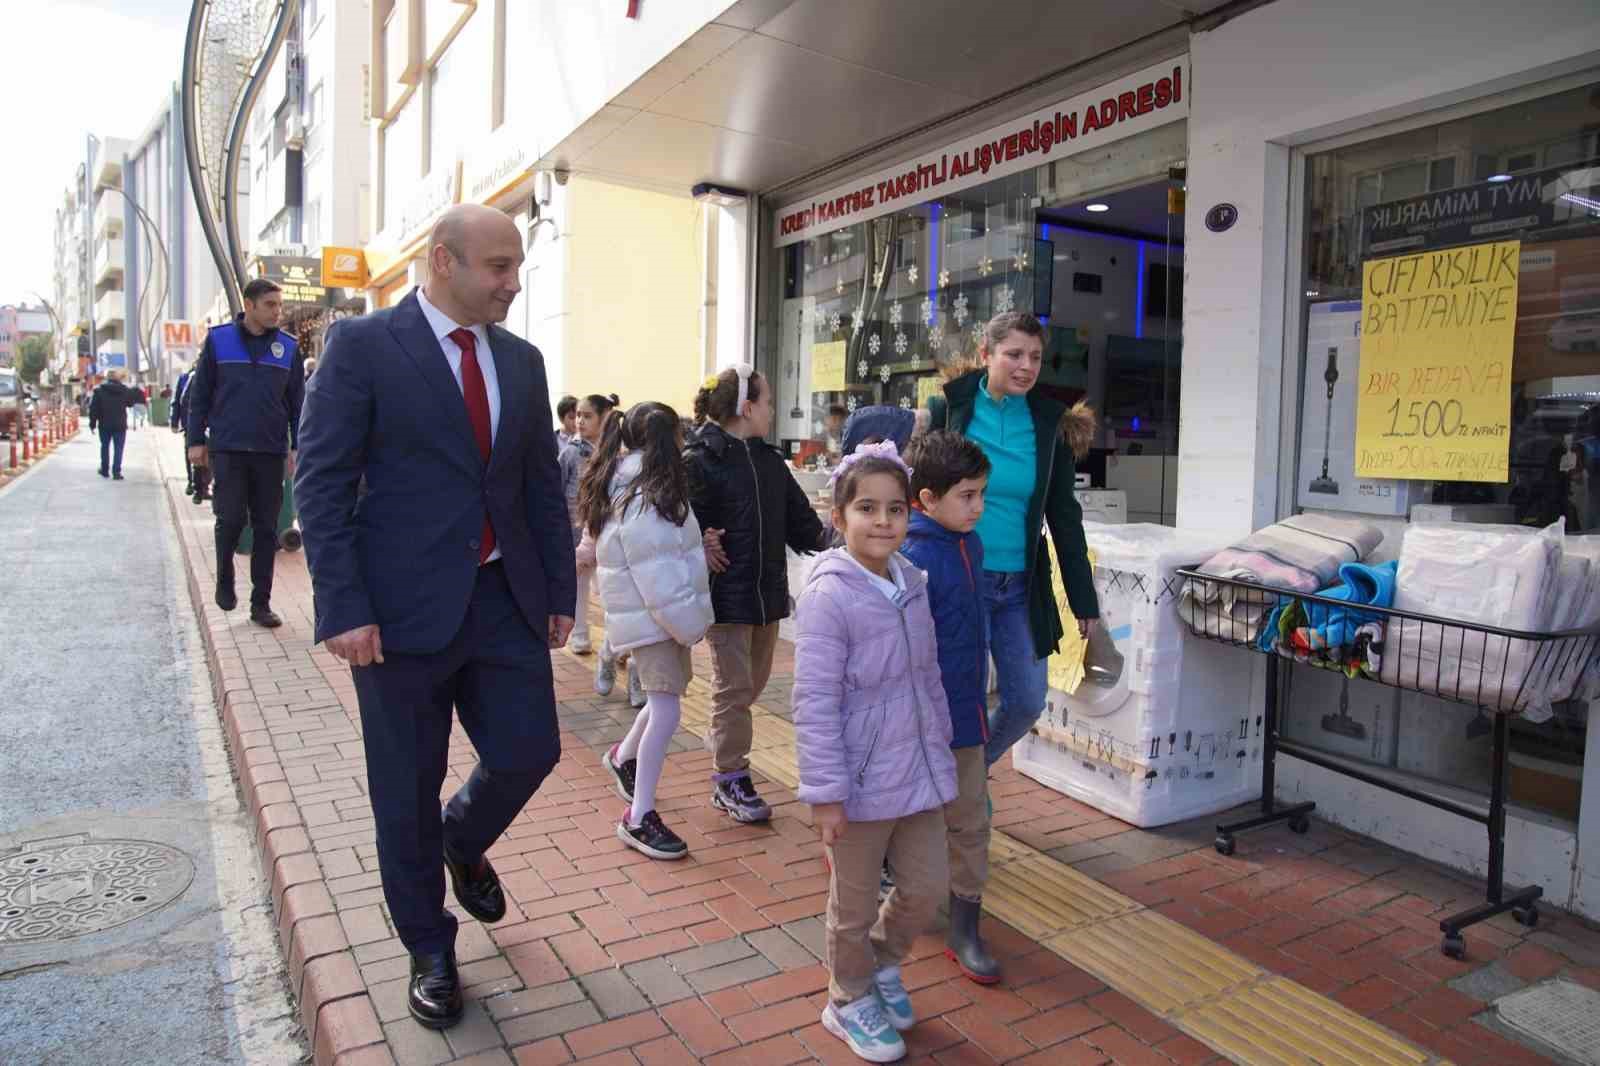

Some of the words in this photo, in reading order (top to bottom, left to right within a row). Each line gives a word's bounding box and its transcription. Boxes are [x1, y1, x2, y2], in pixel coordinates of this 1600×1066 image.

[818, 186, 875, 225] KARTSIZ
[876, 154, 948, 204] TAKSİTLİ
[949, 111, 1078, 180] ALIŞVERİŞİN
[1081, 65, 1182, 136] ADRESİ
